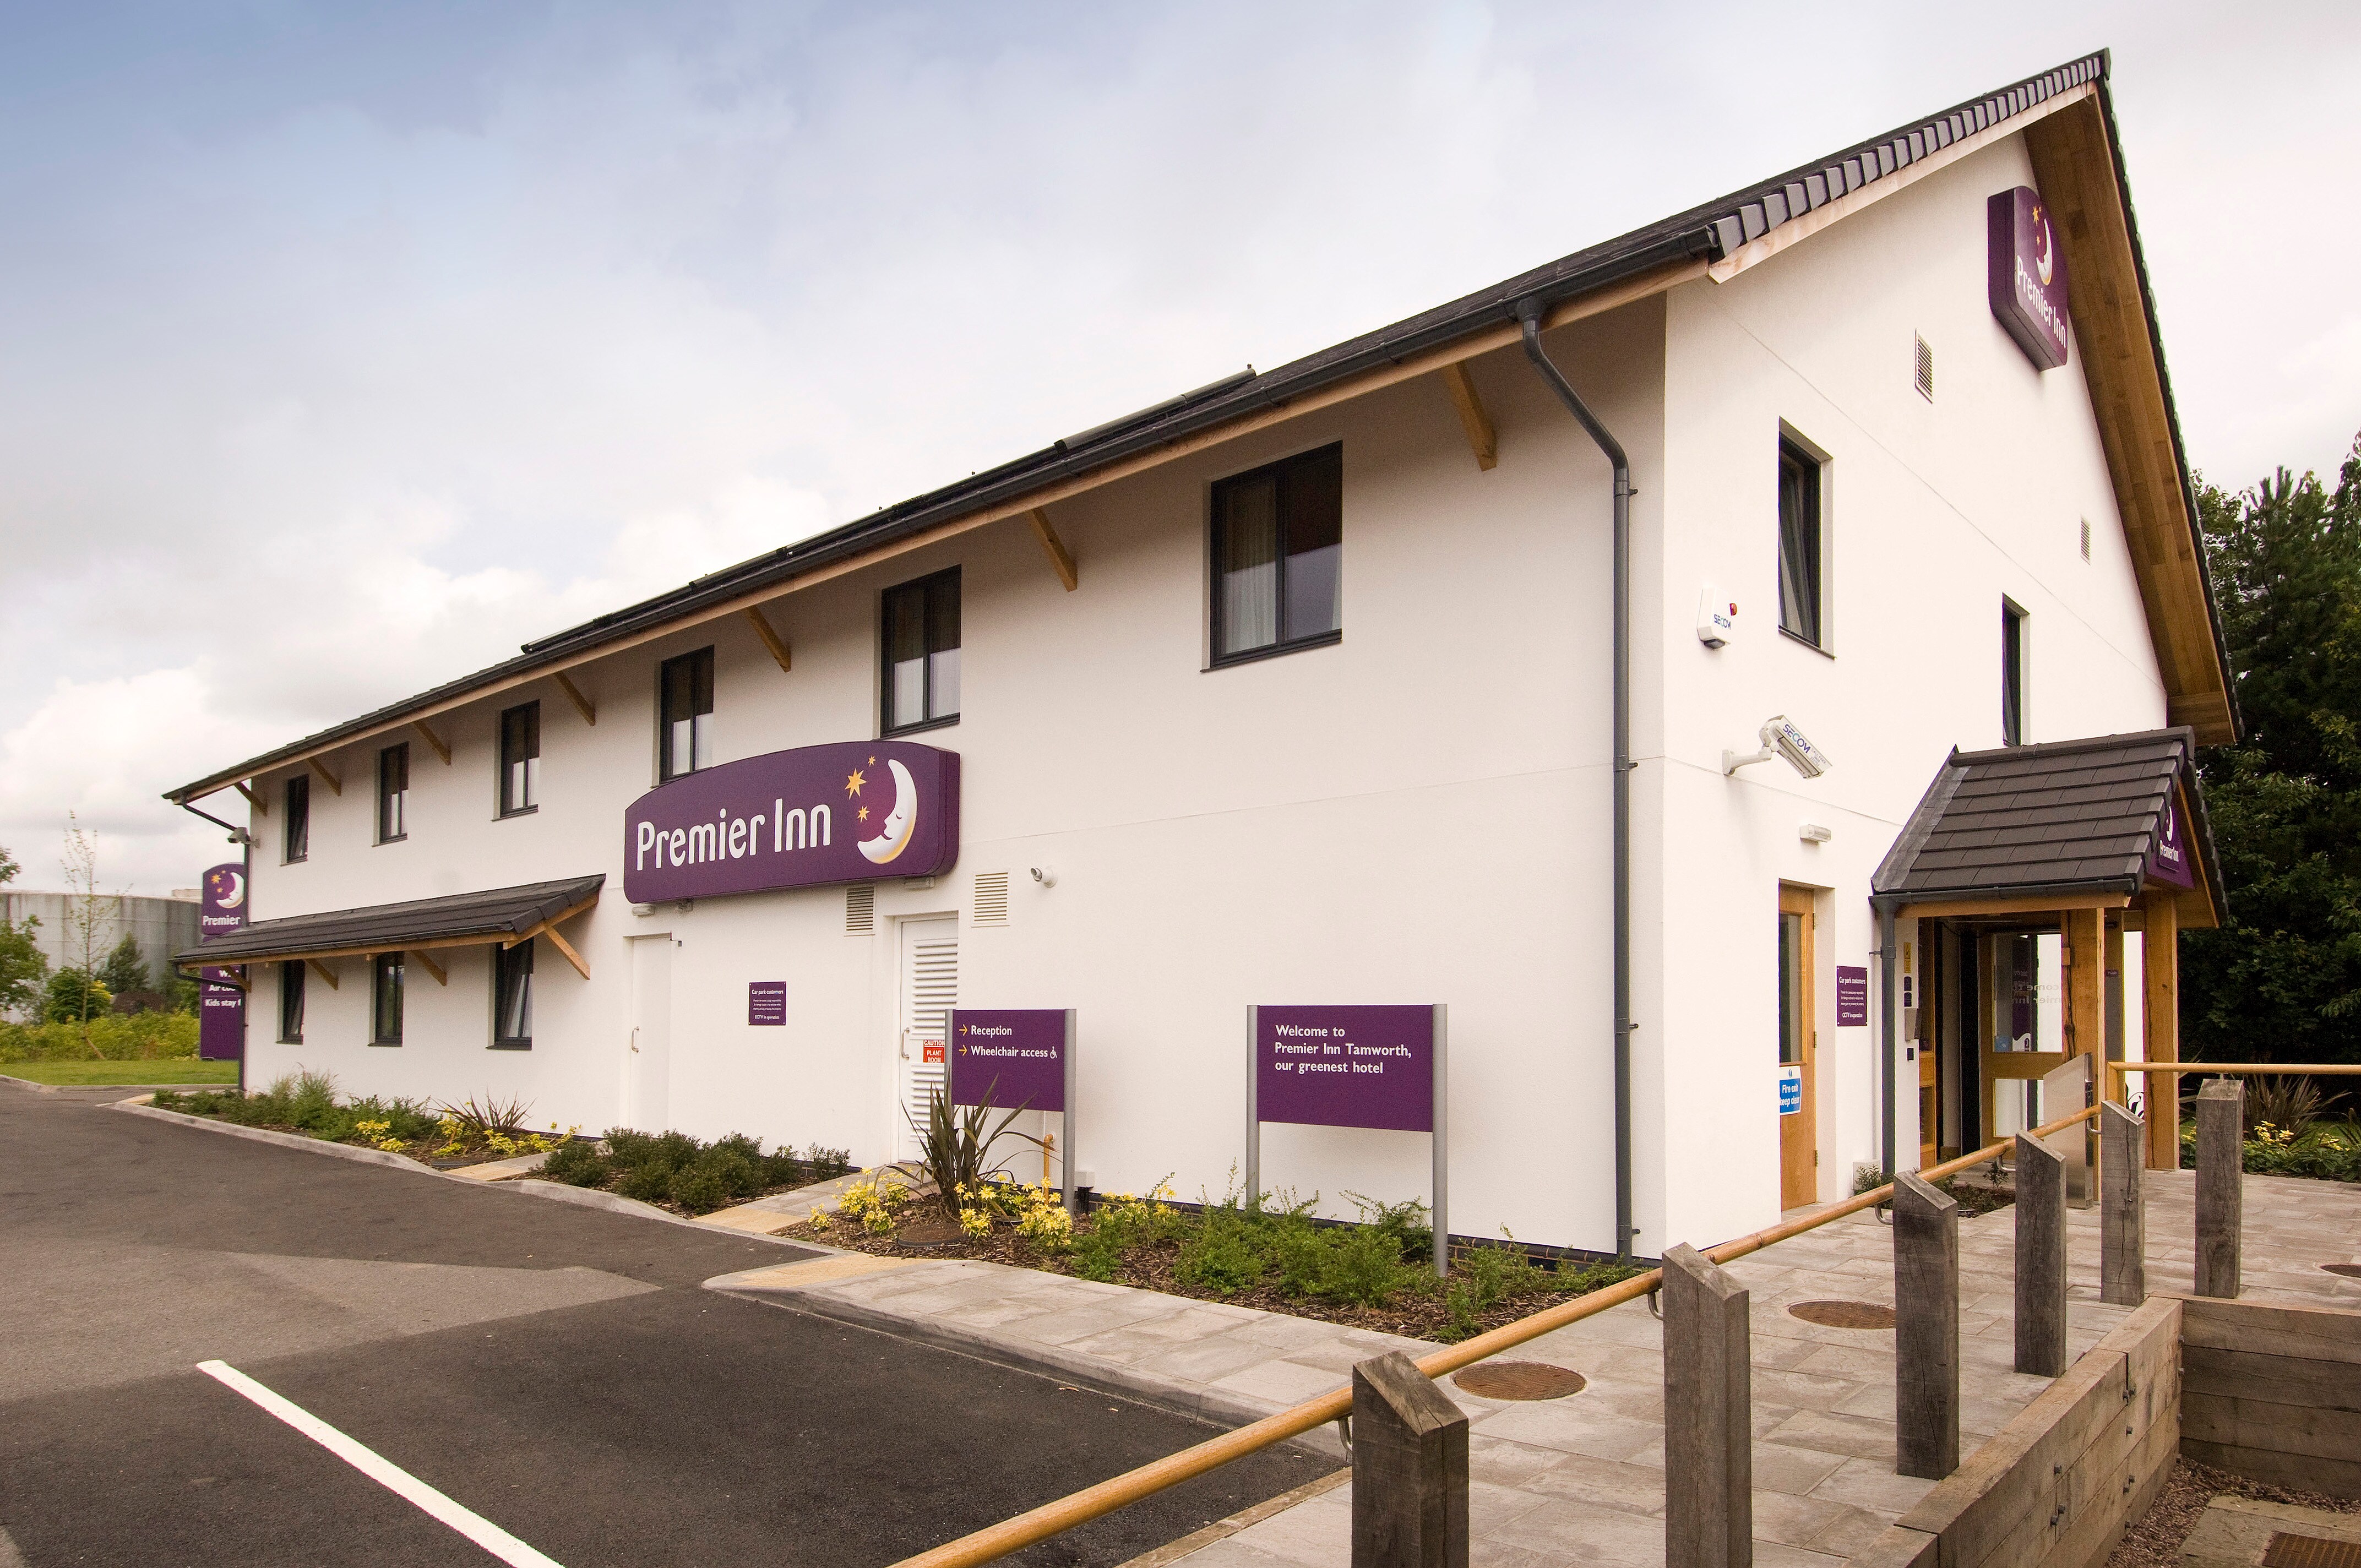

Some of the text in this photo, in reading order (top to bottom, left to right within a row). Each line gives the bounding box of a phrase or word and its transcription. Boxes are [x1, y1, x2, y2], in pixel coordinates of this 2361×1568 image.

[2017, 254, 2066, 349] Premier Inn
[1713, 613, 1731, 630] SECOM
[1782, 723, 1811, 754] SECOM
[636, 798, 831, 871] Premier Inn
[202, 914, 241, 926] Premier
[221, 999, 237, 1008] stay
[971, 1025, 1012, 1038] Reception
[1275, 1025, 1345, 1037] Welcome to
[971, 1045, 1048, 1058] Wheelchair access
[1275, 1042, 1412, 1058] Premier Inn Tamworth,
[1275, 1061, 1383, 1074] our greenest hotel
[1782, 1084, 1791, 1093] Fire
[1791, 1096, 1800, 1105] clear
